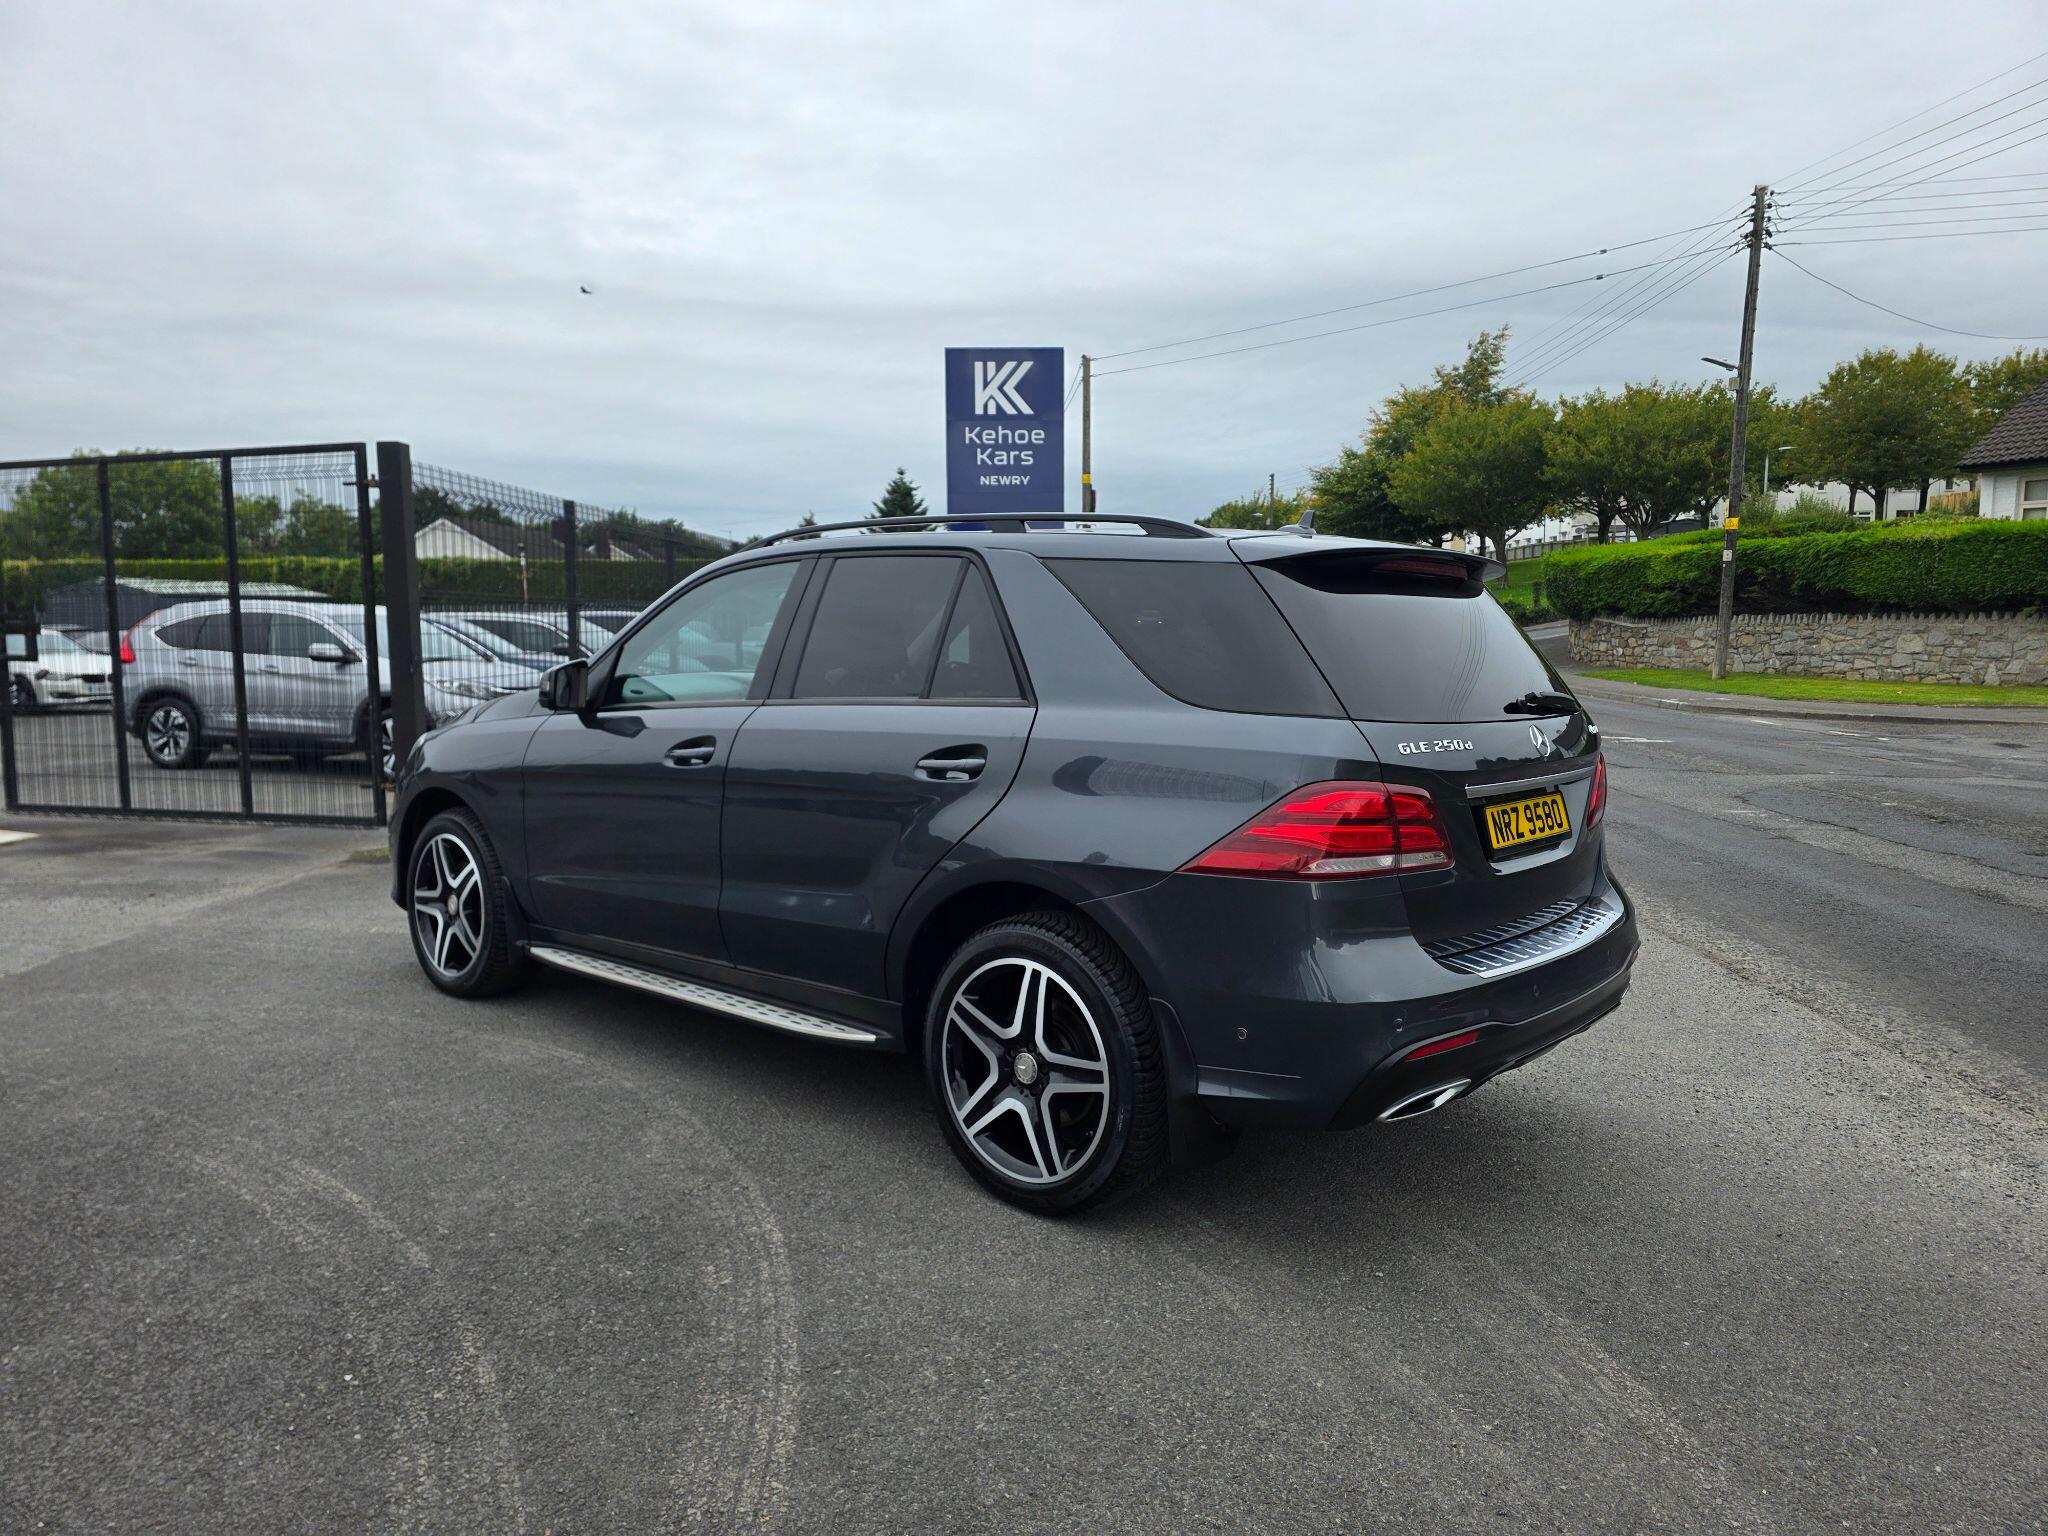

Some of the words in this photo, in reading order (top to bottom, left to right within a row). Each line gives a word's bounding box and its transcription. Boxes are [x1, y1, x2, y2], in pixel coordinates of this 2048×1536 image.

[965, 426, 1045, 444] Kehoe
[976, 448, 1034, 465] Kars
[980, 475, 1031, 485] NEWRY
[1397, 741, 1432, 755] GLE
[1433, 739, 1474, 753] 250d
[1490, 806, 1526, 844] NRZ
[1523, 798, 1564, 836] 9580
